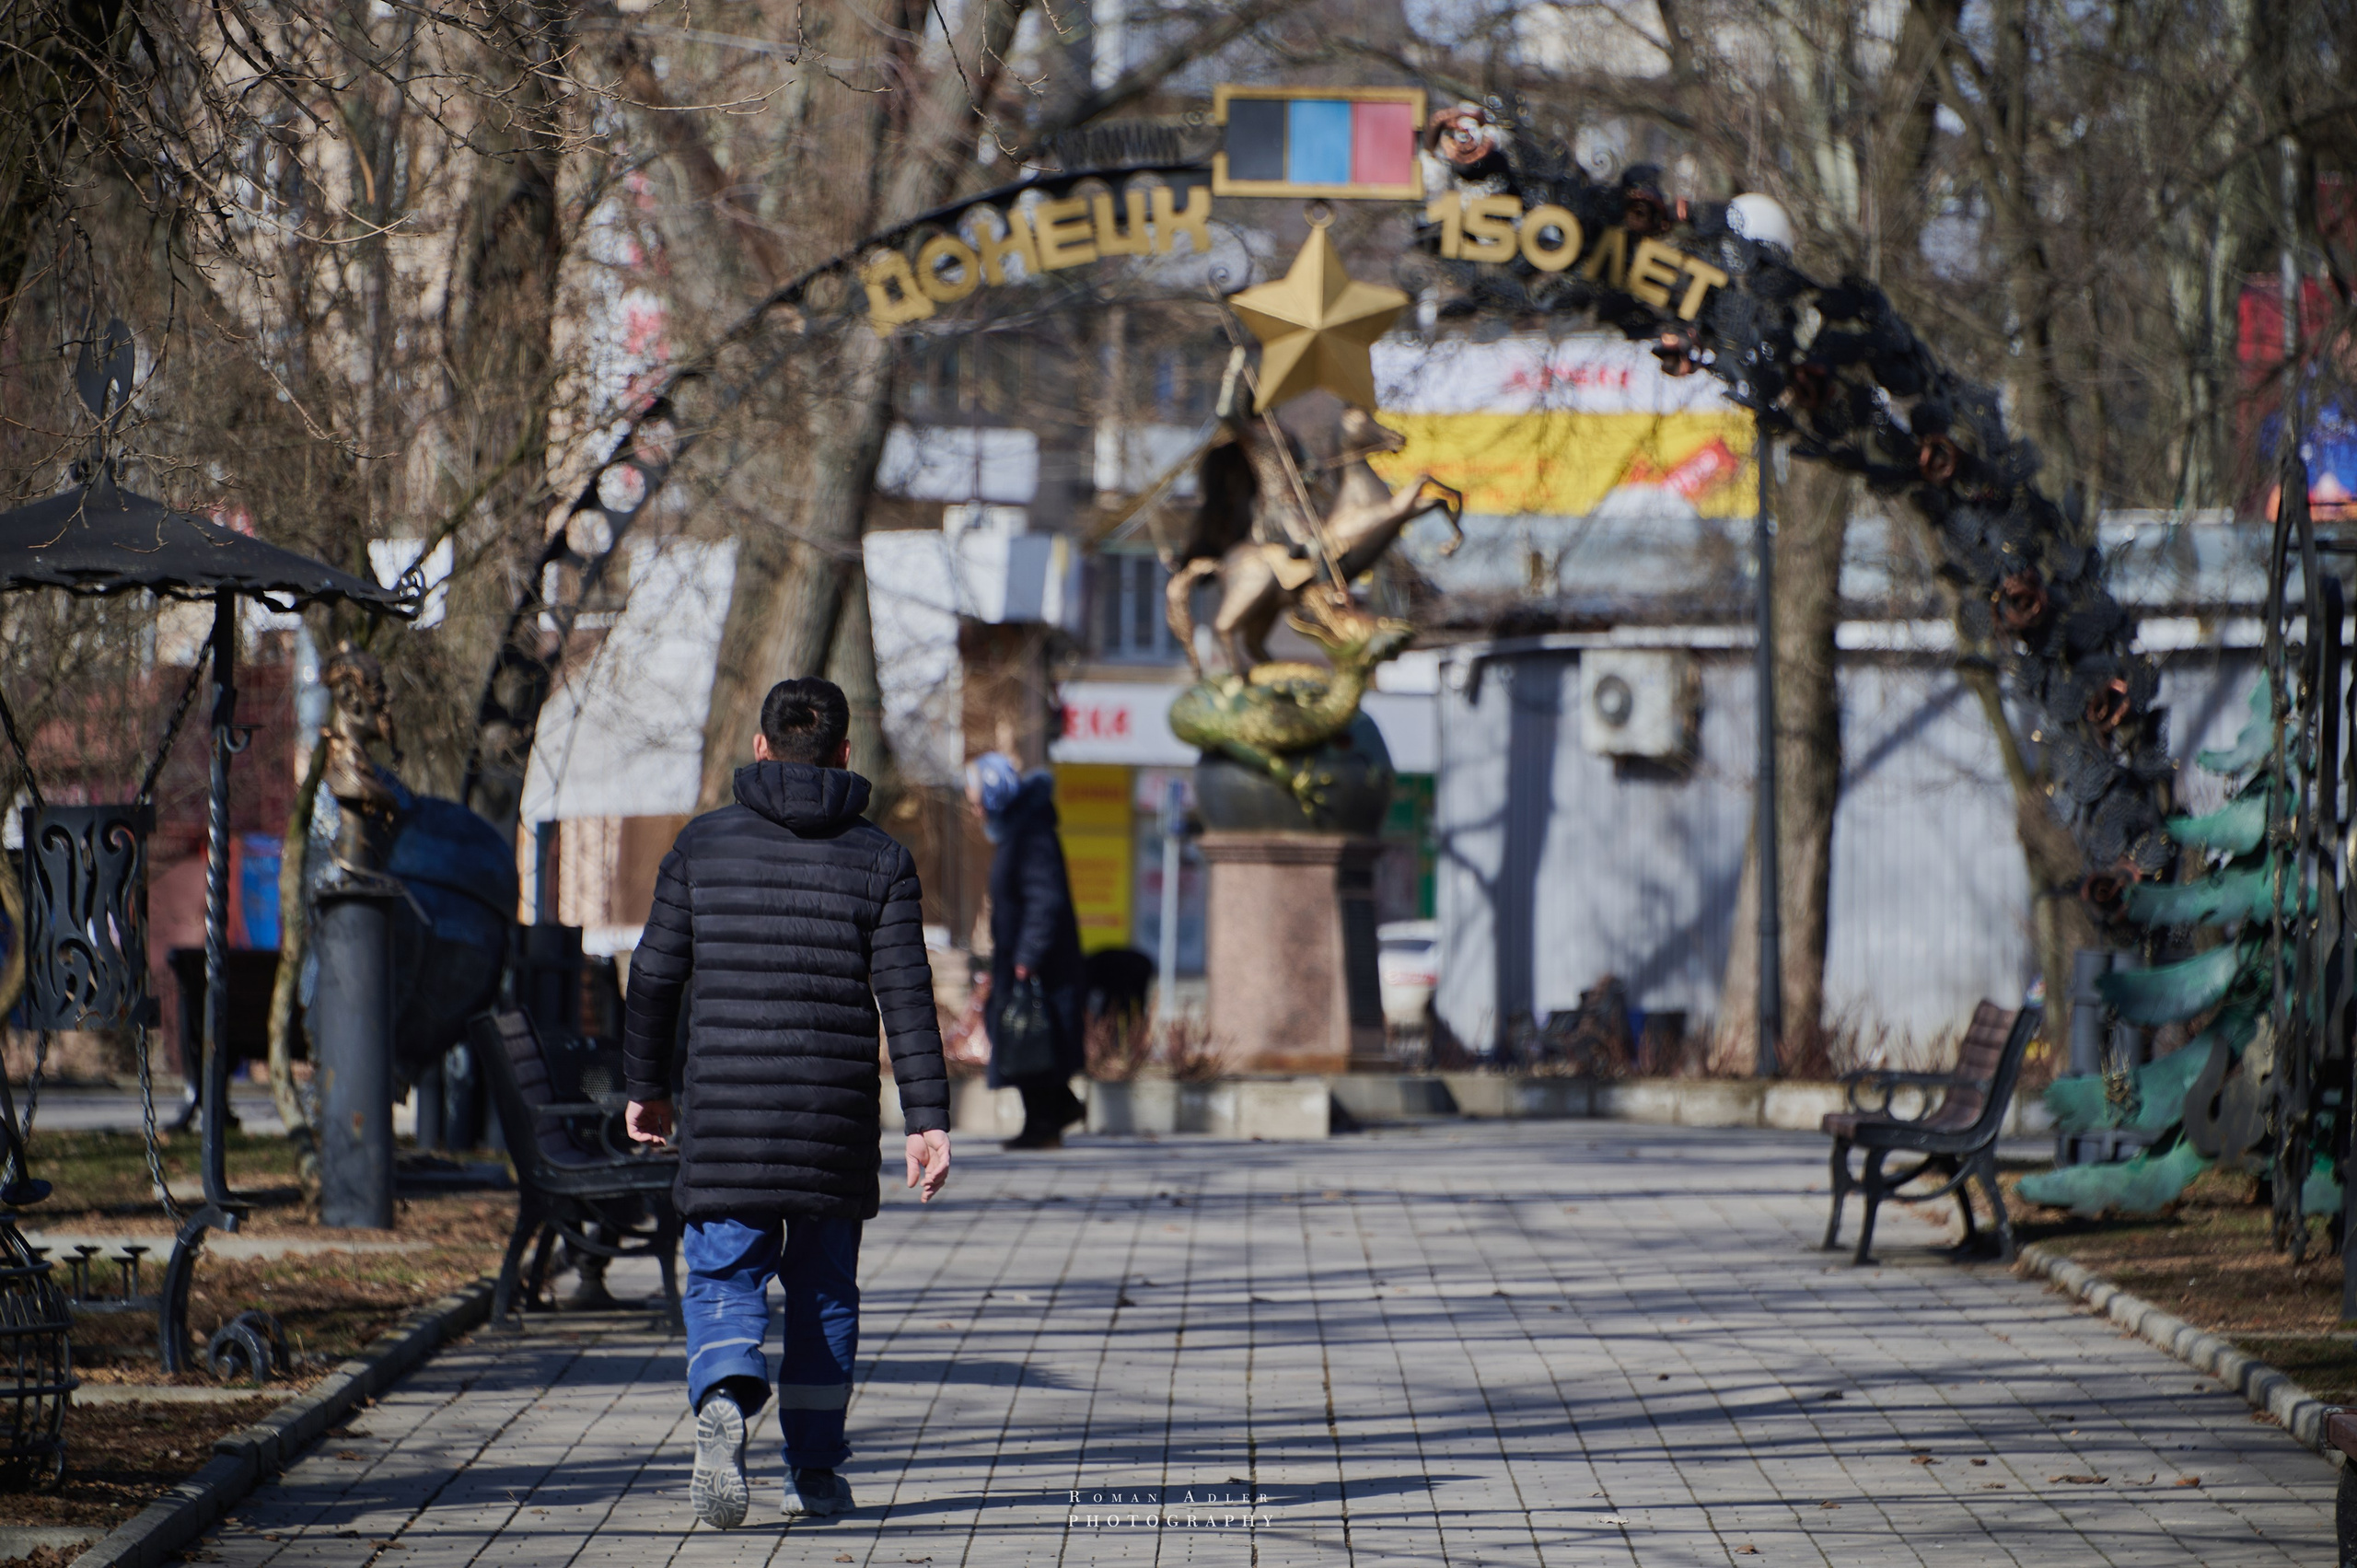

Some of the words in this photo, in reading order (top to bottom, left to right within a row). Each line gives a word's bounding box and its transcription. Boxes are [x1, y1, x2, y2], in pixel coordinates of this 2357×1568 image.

[858, 186, 1212, 338] ДОНЕЦК
[1426, 192, 1584, 273] 150
[1584, 226, 1728, 321] ЛЕТ
